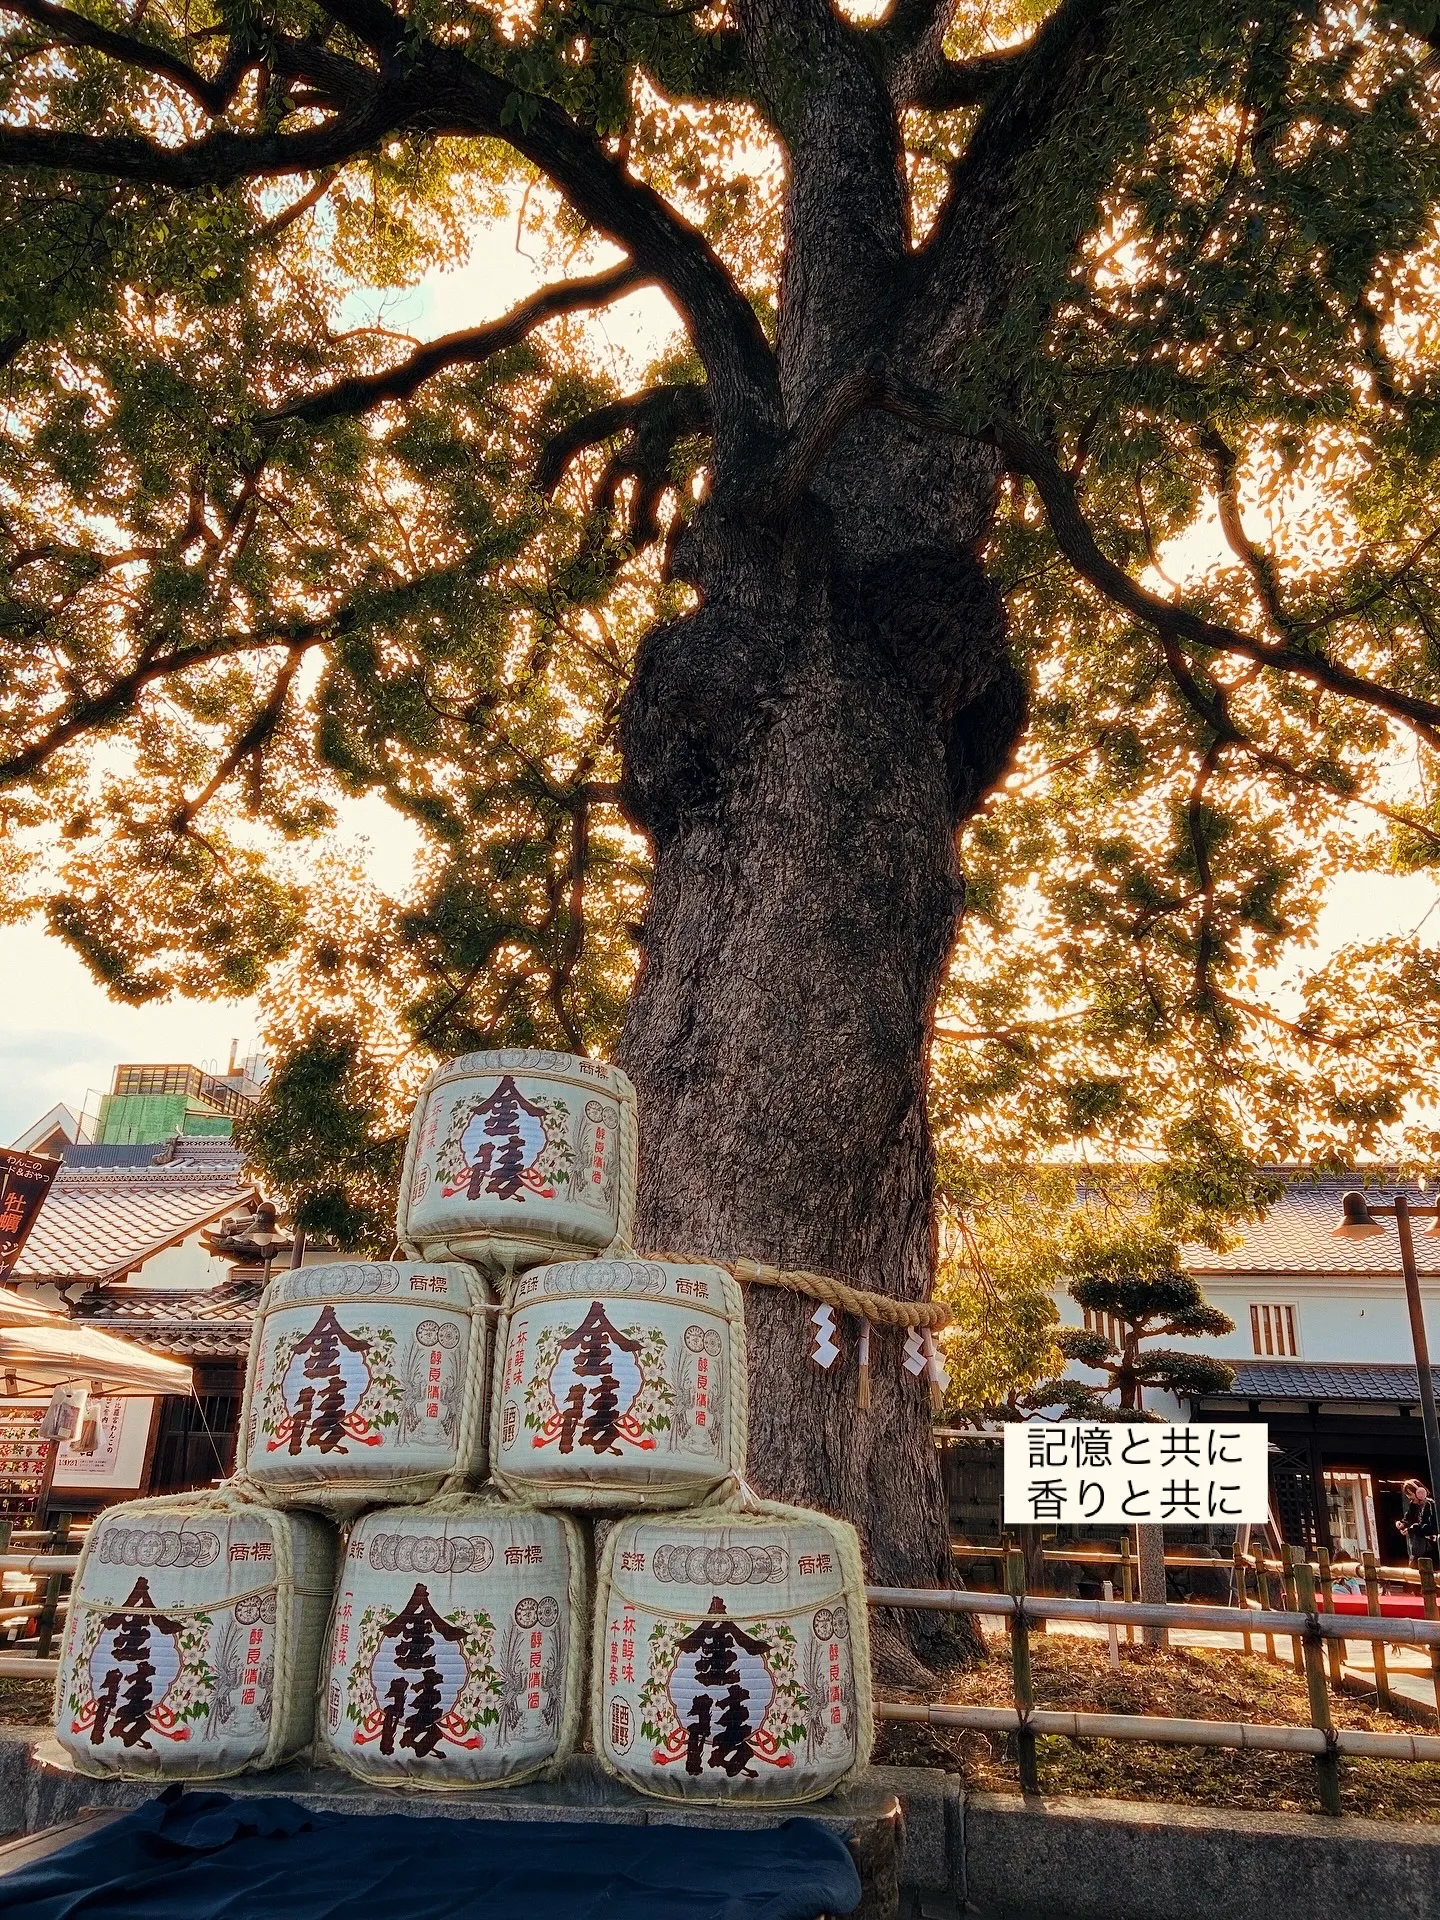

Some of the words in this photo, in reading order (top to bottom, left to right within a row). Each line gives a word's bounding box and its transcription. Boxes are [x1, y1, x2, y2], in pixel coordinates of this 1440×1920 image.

[579, 1060, 609, 1081] 商標
[7, 1155, 42, 1171] わんこの
[409, 1274, 448, 1294] 商標
[675, 1277, 709, 1300] 商標
[229, 1541, 273, 1562] 商標
[504, 1544, 543, 1565] 商標
[797, 1553, 833, 1577] 商標
